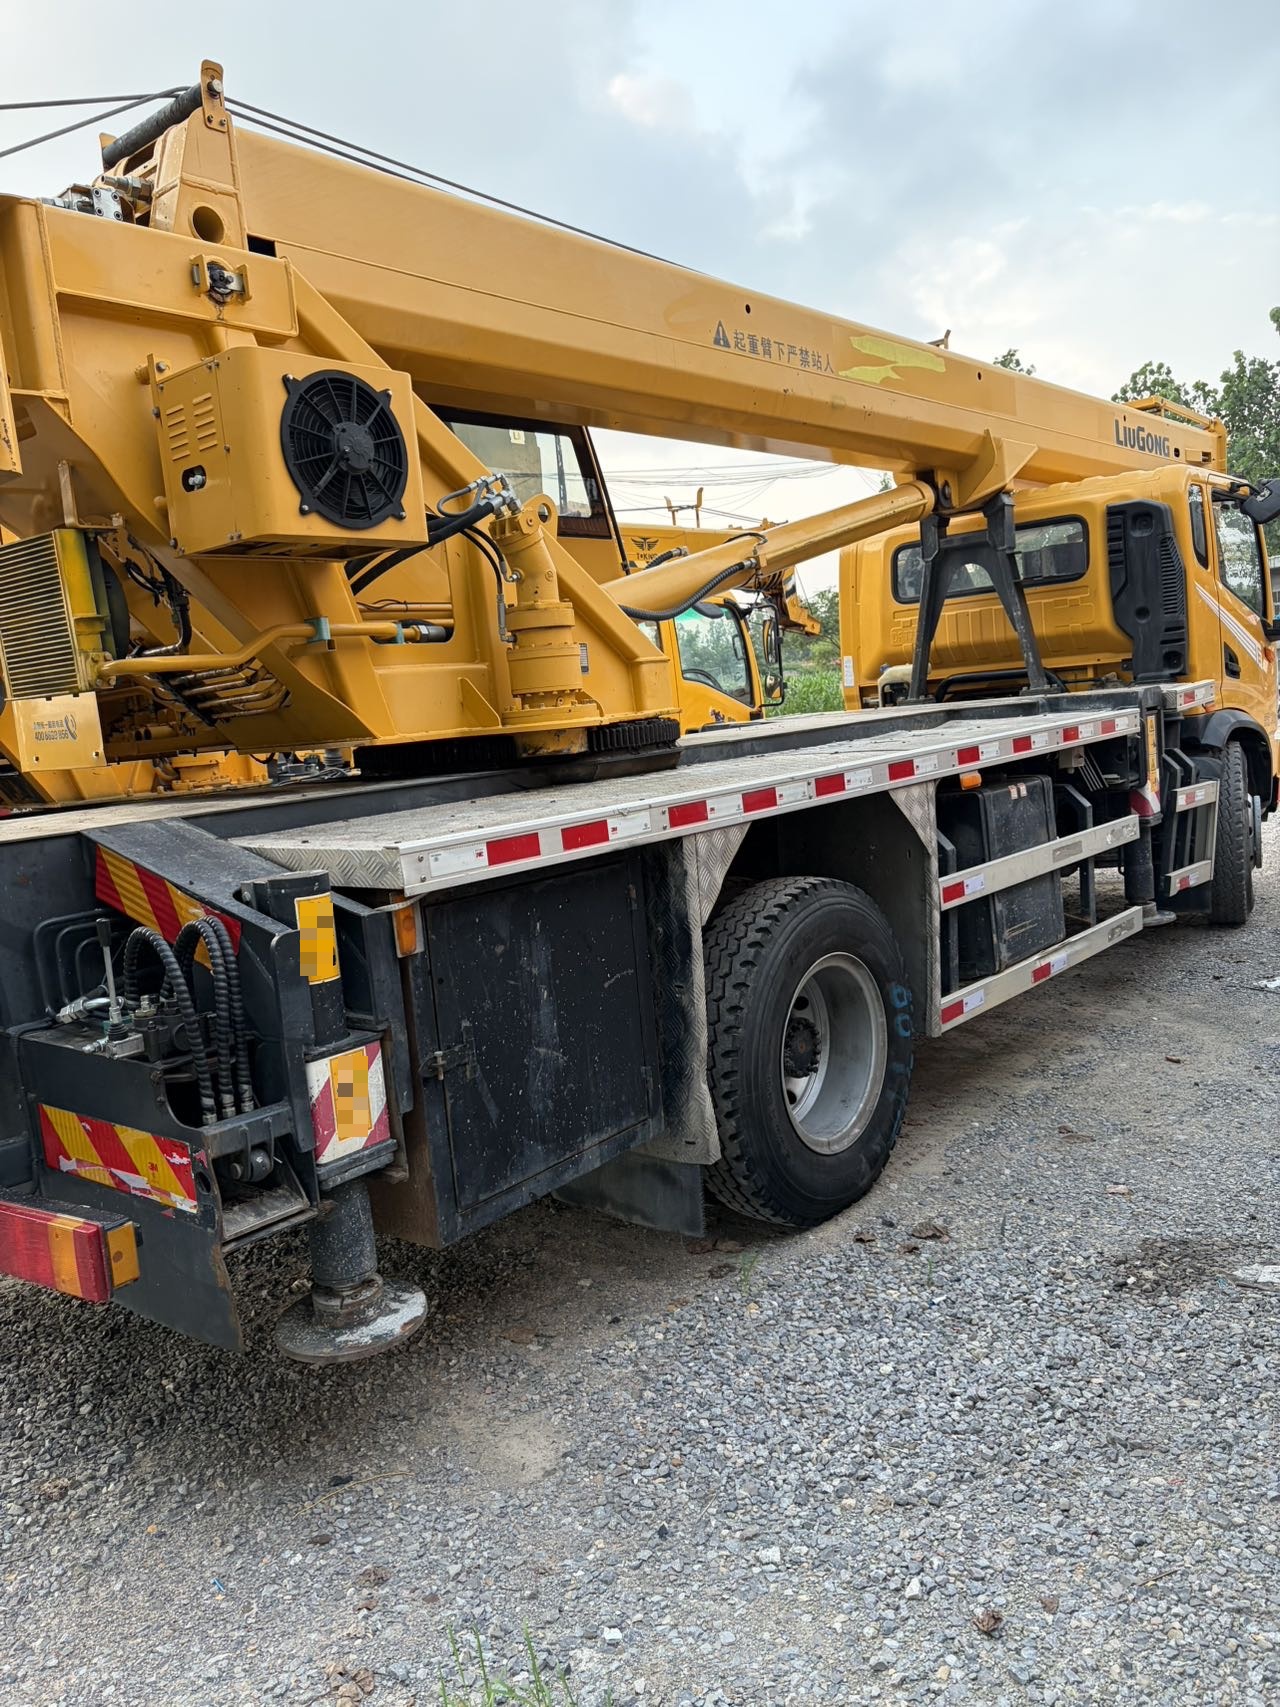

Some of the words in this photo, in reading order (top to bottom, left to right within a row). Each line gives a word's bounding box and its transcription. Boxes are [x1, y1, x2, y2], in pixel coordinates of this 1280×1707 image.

[733, 329, 835, 374] 起重臂下严禁站人
